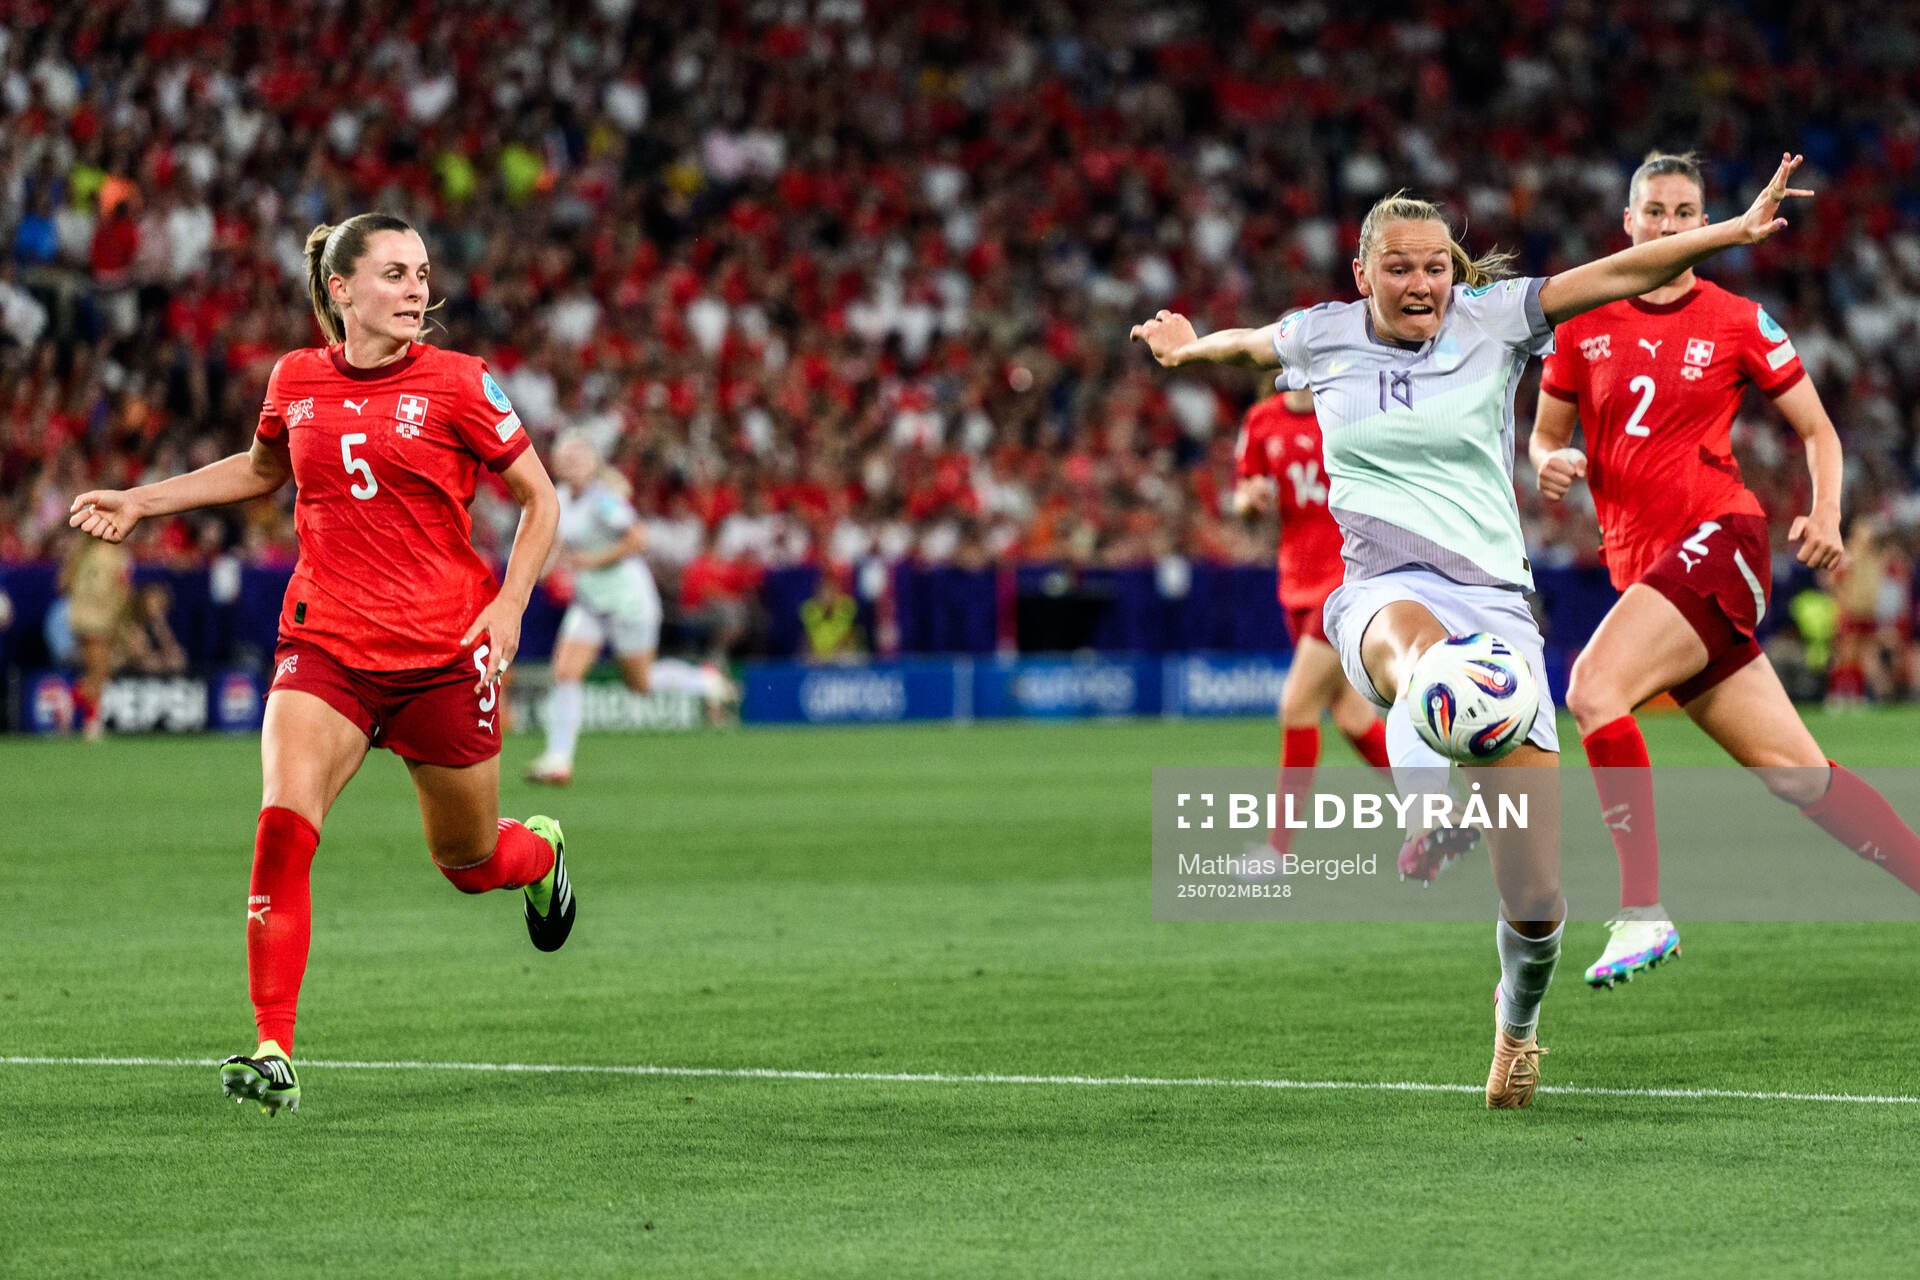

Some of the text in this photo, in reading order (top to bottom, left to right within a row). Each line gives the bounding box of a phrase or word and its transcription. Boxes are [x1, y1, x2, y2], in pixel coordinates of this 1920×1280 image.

[1379, 370, 1413, 413] 18
[1625, 375, 1656, 437] 2
[341, 433, 378, 499] 5
[1682, 521, 1722, 556] 2
